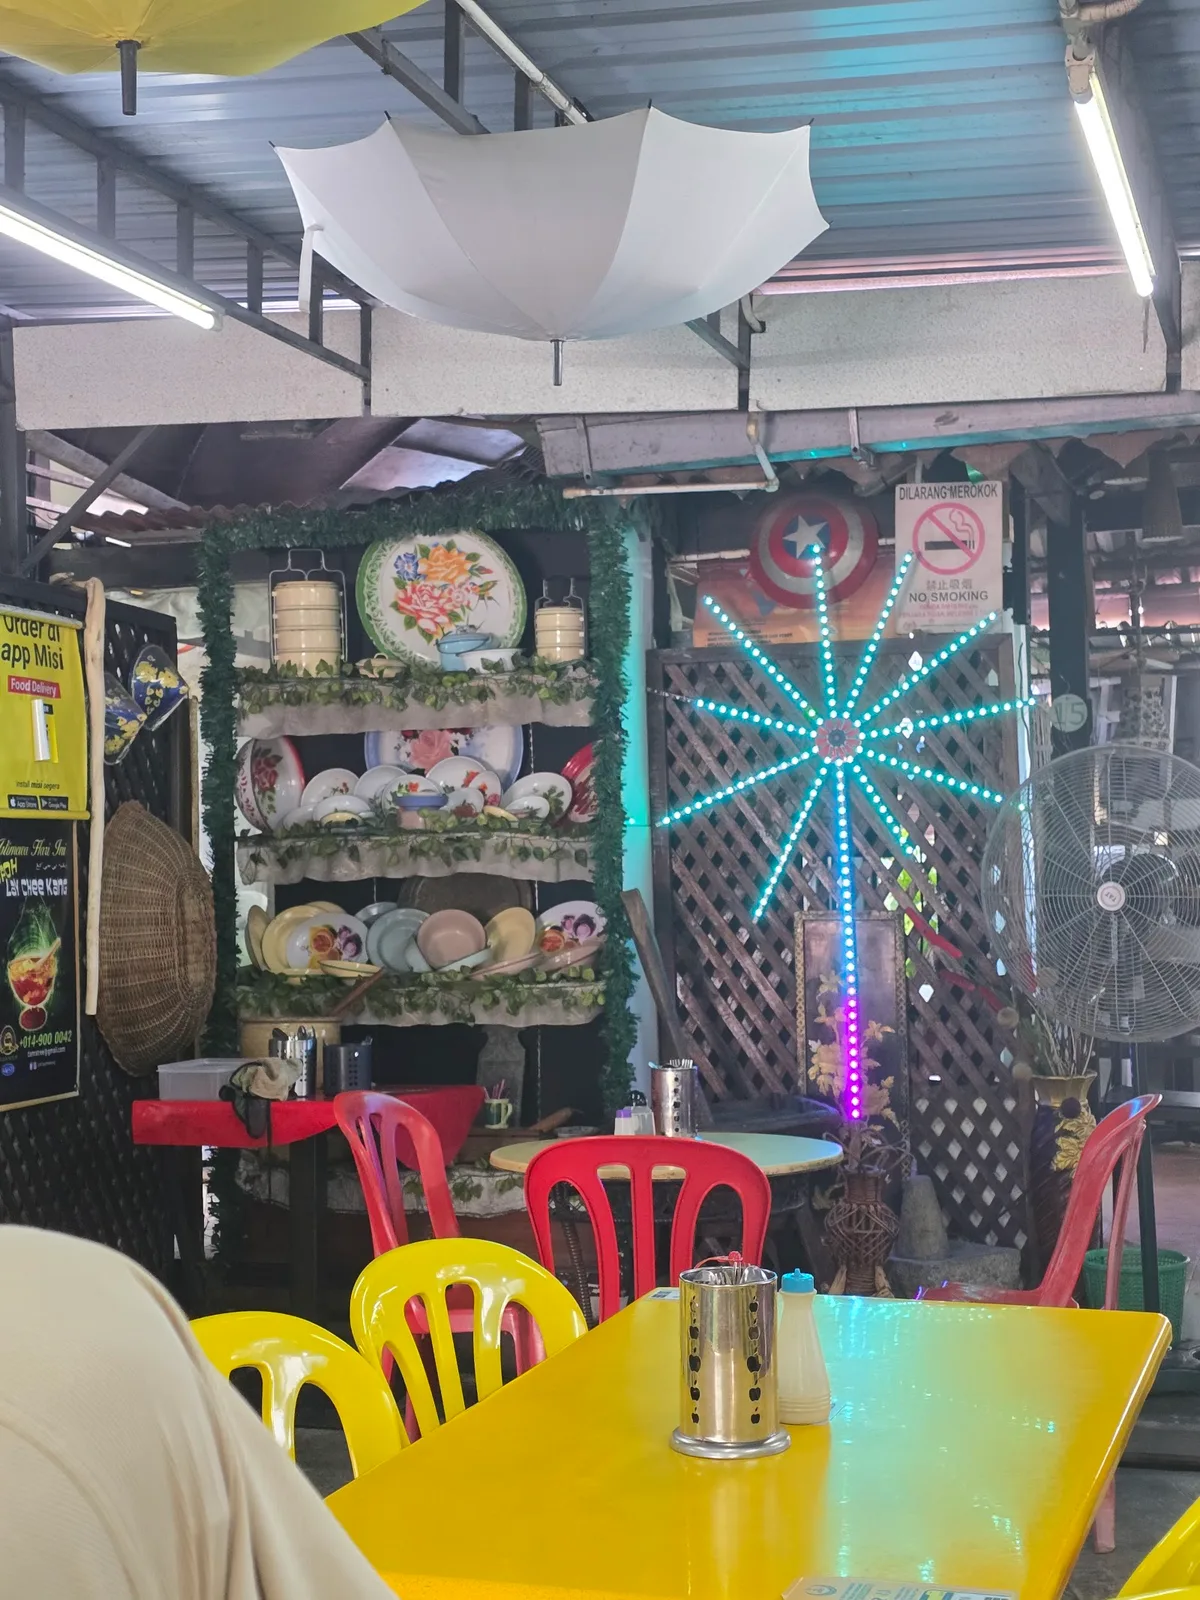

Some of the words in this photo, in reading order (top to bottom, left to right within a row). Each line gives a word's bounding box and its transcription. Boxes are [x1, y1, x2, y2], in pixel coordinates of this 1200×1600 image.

[899, 486, 947, 500] DILARANG
[949, 484, 998, 499] MEROKOK
[909, 592, 927, 603] NO
[930, 590, 989, 602] SMOKING
[3, 615, 44, 639] Order
[1, 642, 31, 670] app
[33, 643, 64, 670] Misi
[11, 678, 31, 692] Food
[31, 680, 57, 698] Delivery
